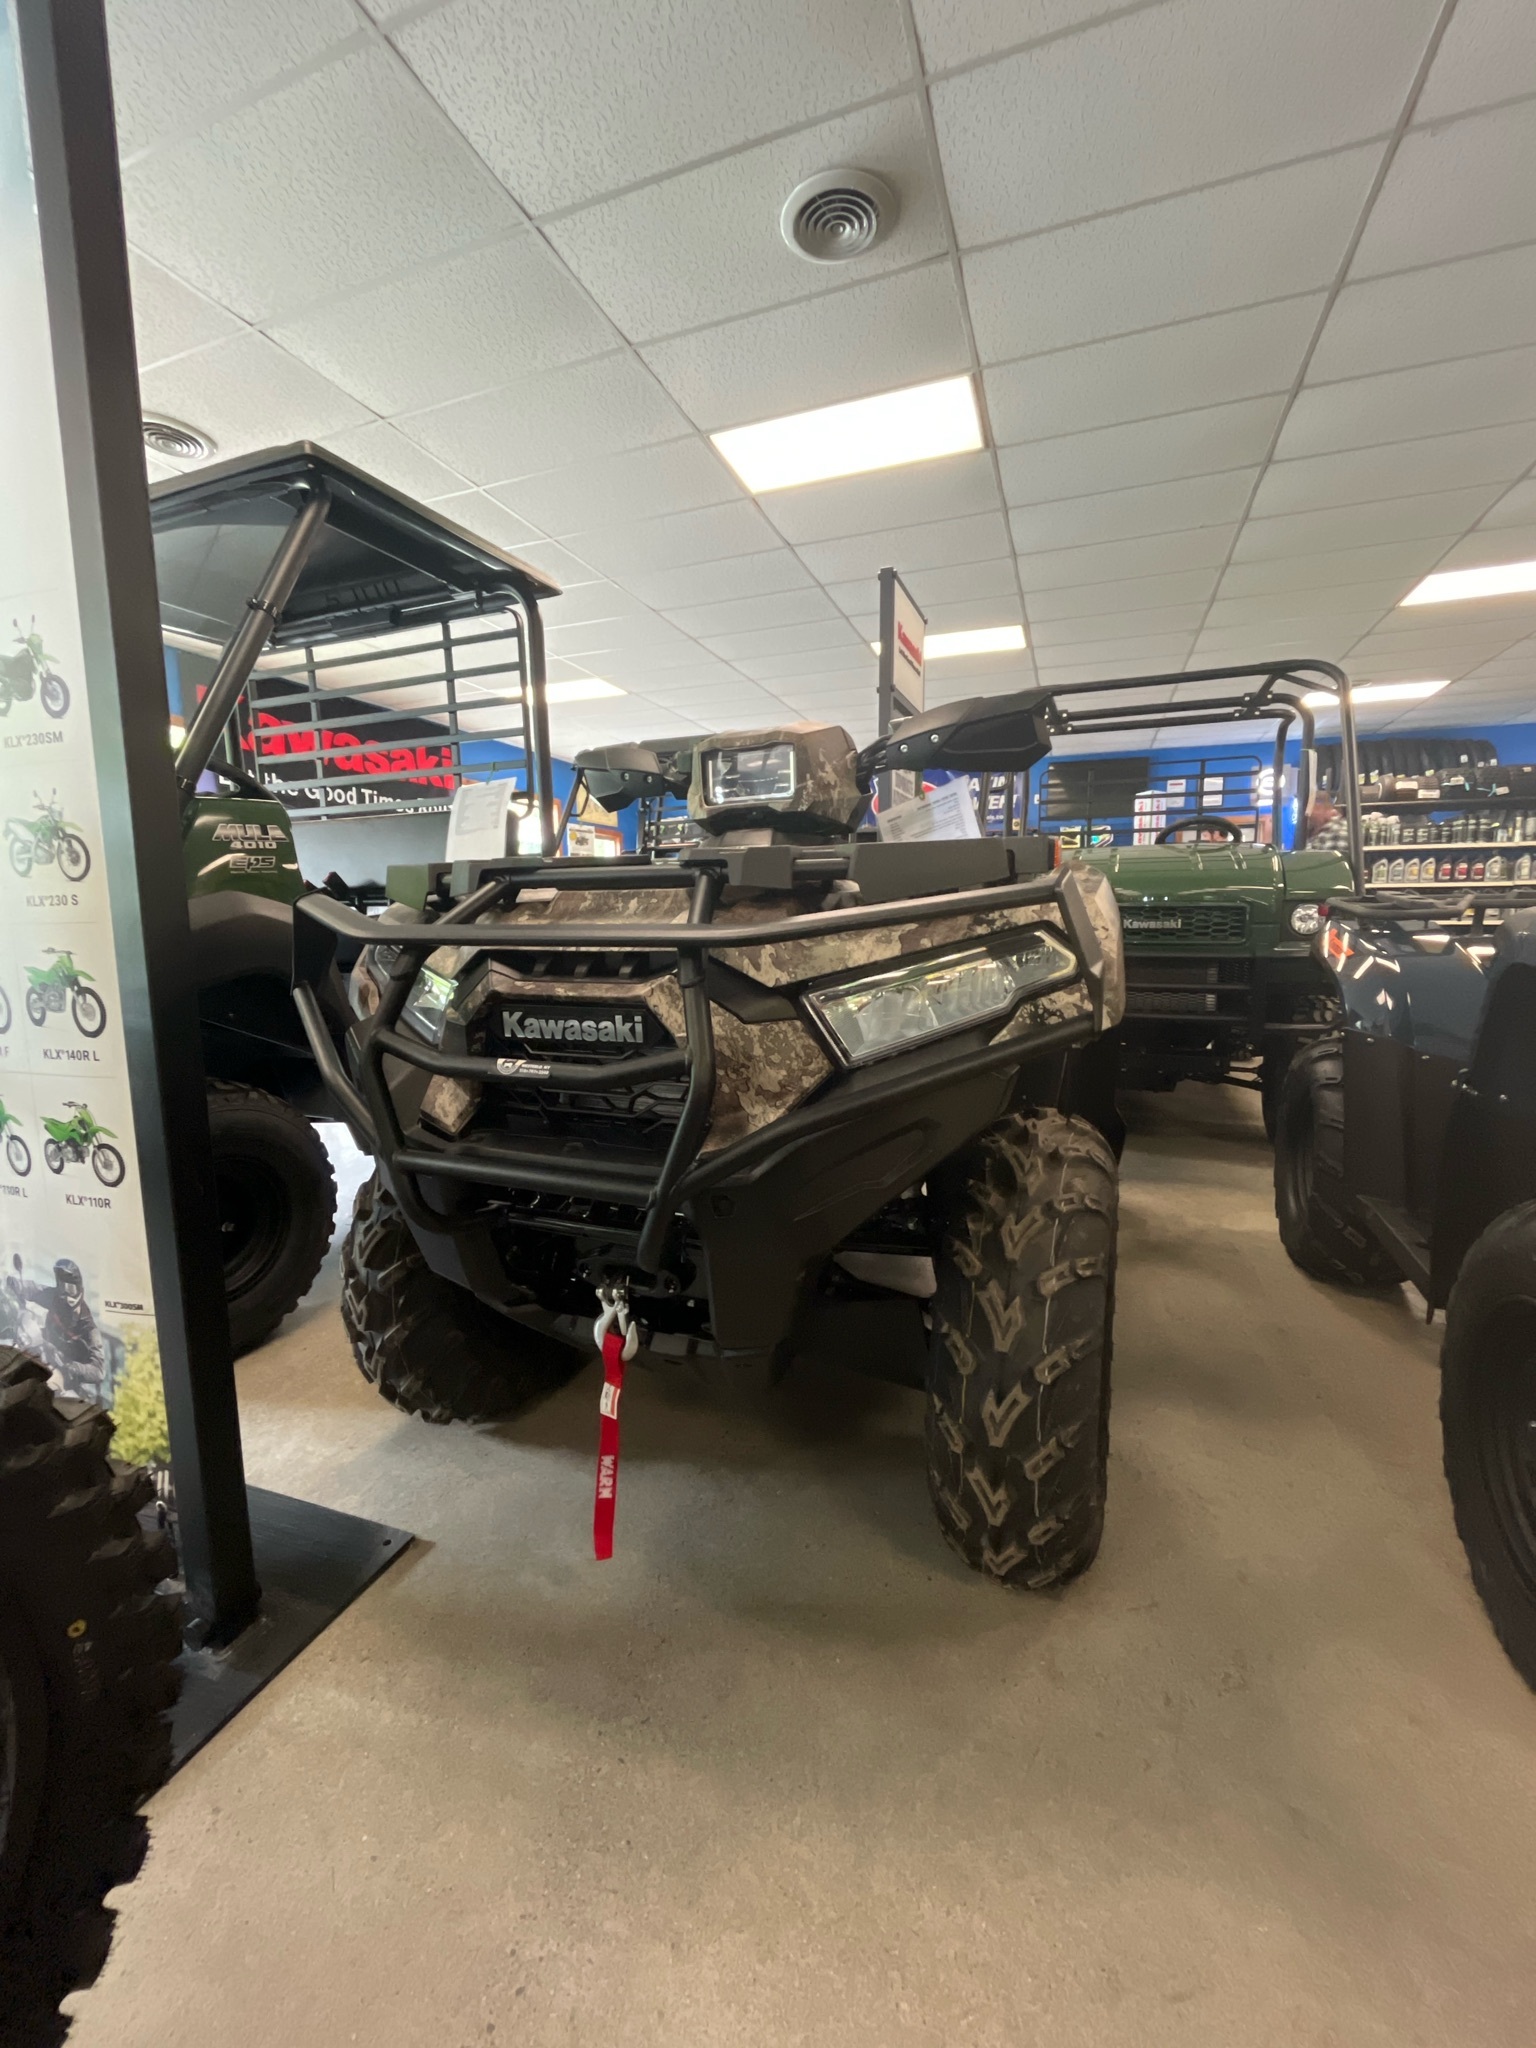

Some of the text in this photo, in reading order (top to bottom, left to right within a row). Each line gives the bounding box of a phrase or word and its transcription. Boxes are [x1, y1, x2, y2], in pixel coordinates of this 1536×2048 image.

[212, 823, 289, 842] MULE
[230, 841, 277, 850] 4010
[71, 894, 79, 906] S
[1123, 919, 1182, 929] Kawasaki
[502, 1010, 644, 1044] Kawasaki
[93, 1051, 100, 1062] L
[598, 1454, 616, 1499] WARN
